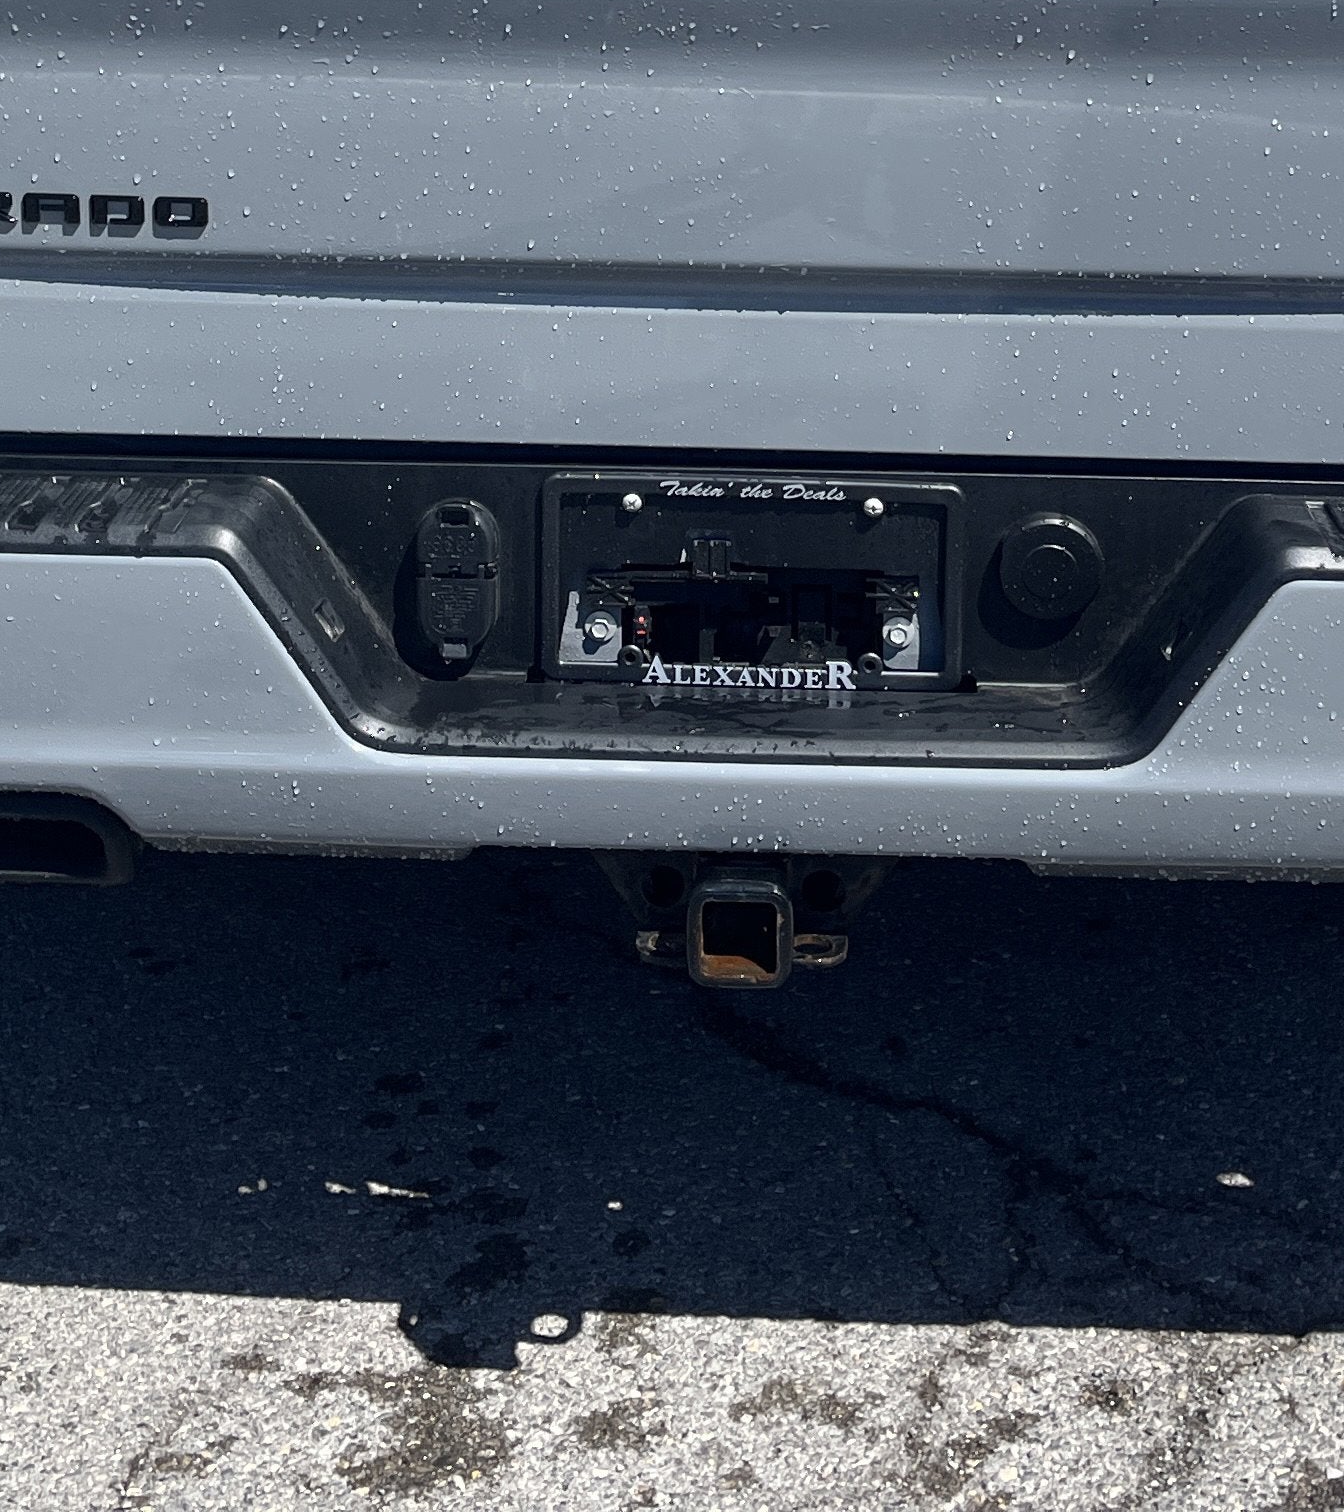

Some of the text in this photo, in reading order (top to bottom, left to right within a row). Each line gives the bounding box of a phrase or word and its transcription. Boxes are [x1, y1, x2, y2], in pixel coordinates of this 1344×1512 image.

[659, 480, 847, 501] Takin' the Deals
[641, 654, 857, 690] ALEXANDER
